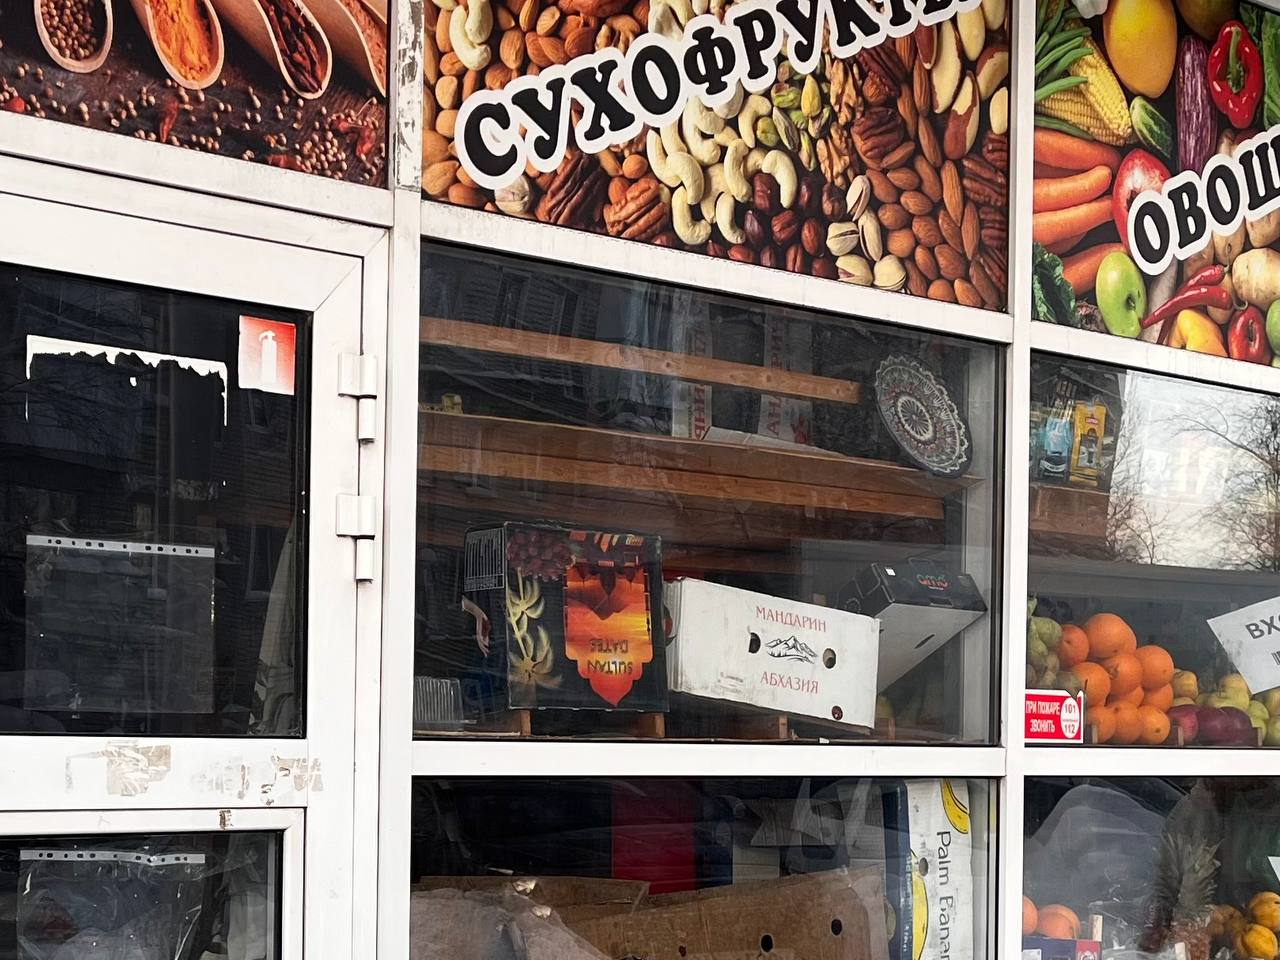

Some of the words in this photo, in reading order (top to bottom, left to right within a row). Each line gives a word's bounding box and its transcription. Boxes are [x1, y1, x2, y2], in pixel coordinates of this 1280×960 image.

[464, 0, 976, 176] СУХОФРУК
[756, 606, 826, 632] МАНДАРИН
[1245, 615, 1280, 640] ВХ
[587, 659, 633, 675] SULTAN
[760, 671, 819, 694] АБХАЗИЯ
[1026, 700, 1038, 714] ПРИ
[1038, 701, 1060, 715] ПОЖАРЕ
[1064, 703, 1076, 713] 101
[1030, 719, 1055, 732] ЗВОНИТЬ
[1064, 723, 1075, 733] 112
[936, 831, 951, 886] Palm
